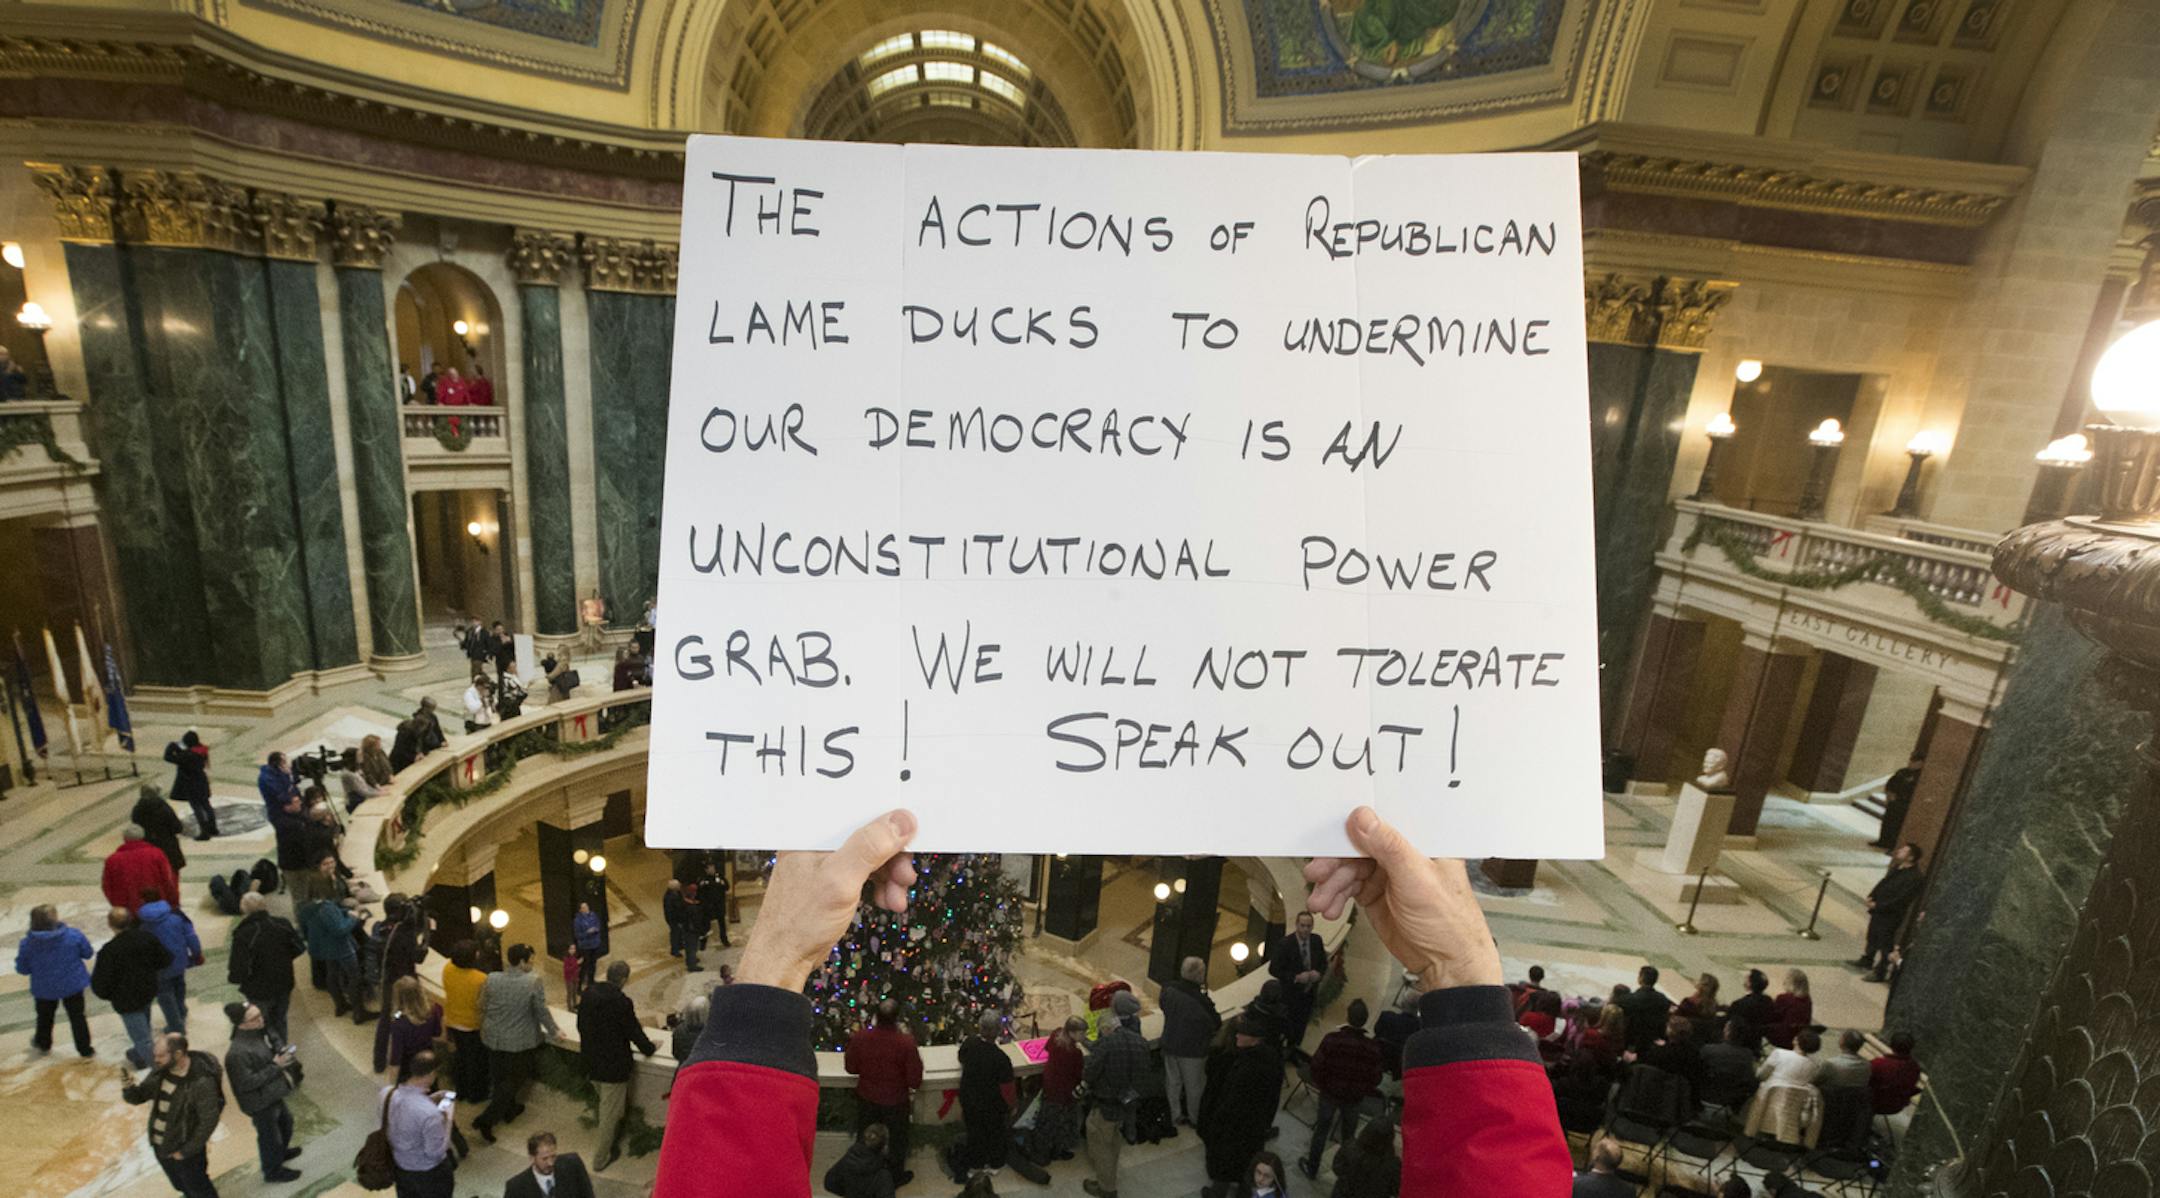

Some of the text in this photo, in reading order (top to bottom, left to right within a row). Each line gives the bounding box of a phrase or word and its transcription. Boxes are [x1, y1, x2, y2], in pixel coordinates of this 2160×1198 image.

[919, 196, 1174, 257] ACTIONS
[1211, 221, 1256, 255] OF
[708, 299, 1550, 367] LAME DUCKS TO UNDERMINE
[700, 402, 1403, 473] OUR DEMOCRACY IS AN
[689, 523, 1498, 593] UNCONSTITUTIONAL POWER
[674, 629, 853, 689] GRAB.
[1046, 641, 1157, 690] WILL
[1192, 646, 1308, 691] NOT
[1336, 645, 1567, 691] TOLERATE
[1789, 611, 1952, 670] EAST GALLERY
